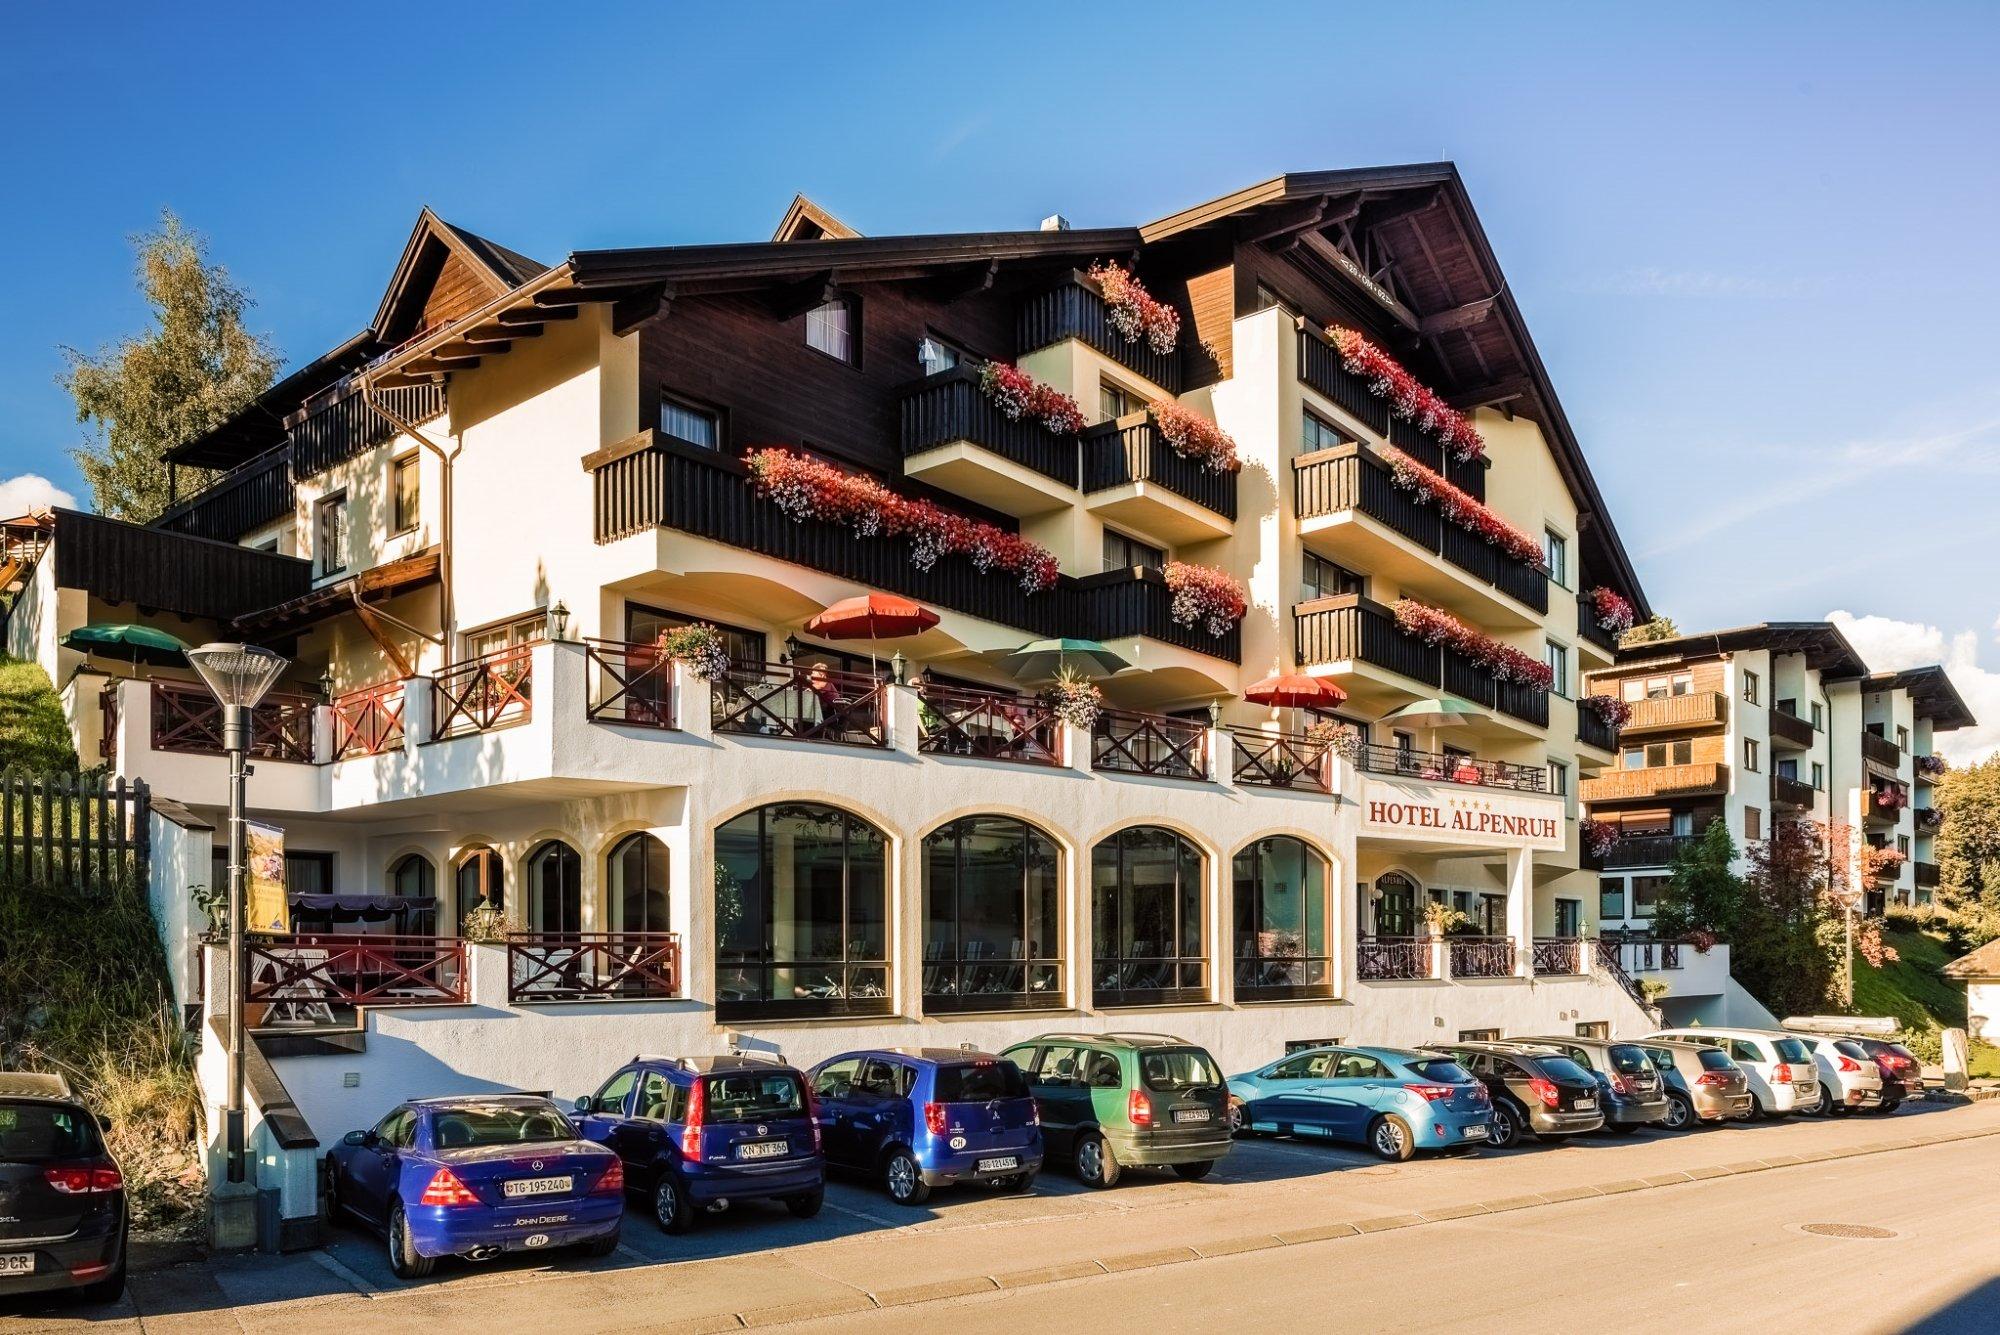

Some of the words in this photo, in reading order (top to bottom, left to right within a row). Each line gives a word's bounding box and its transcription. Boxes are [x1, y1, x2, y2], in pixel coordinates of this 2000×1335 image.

[1369, 801, 1447, 829] HOTEL
[1451, 809, 1557, 838] ALPENRUH
[952, 1138, 963, 1147] CH
[742, 1145, 755, 1156] KN
[773, 1143, 787, 1152] 366
[512, 1217, 538, 1226] JOHN
[539, 1215, 568, 1224] DEERE
[529, 1235, 544, 1246] CH
[10, 1256, 28, 1269] CR
